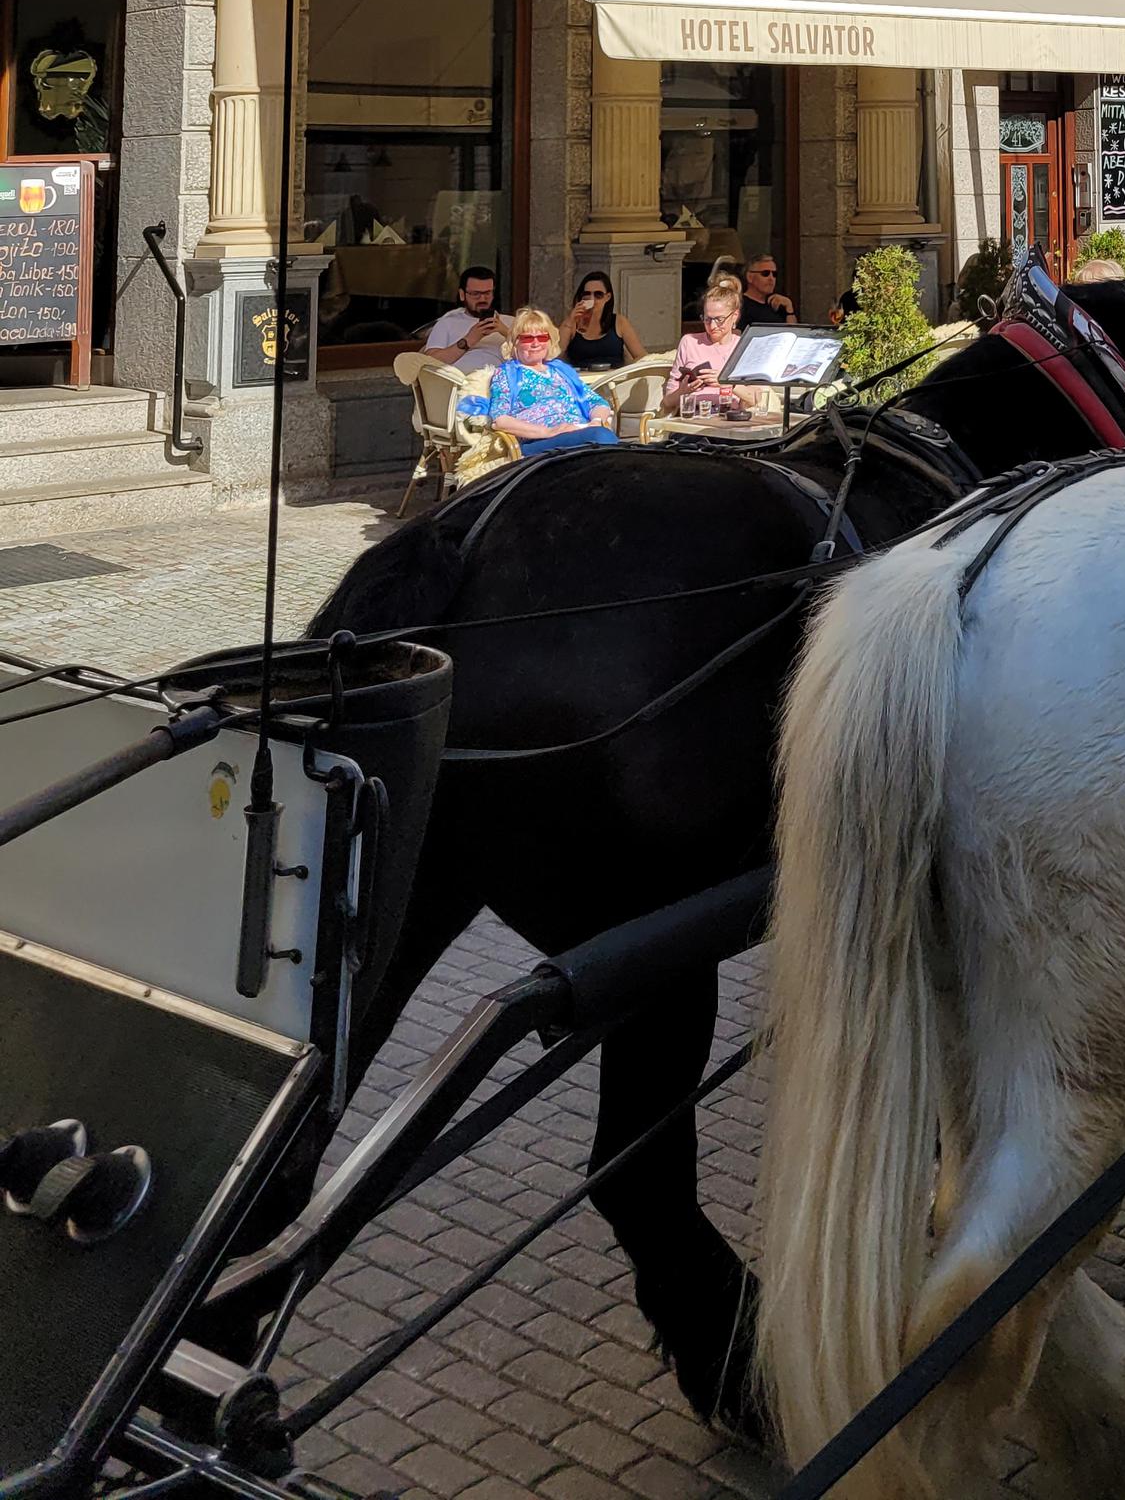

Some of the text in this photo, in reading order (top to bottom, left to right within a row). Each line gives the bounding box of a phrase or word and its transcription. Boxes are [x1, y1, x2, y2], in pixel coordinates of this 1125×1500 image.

[681, 18, 876, 56] HOTEL SALVATOR
[252, 308, 300, 327] Salvtor
